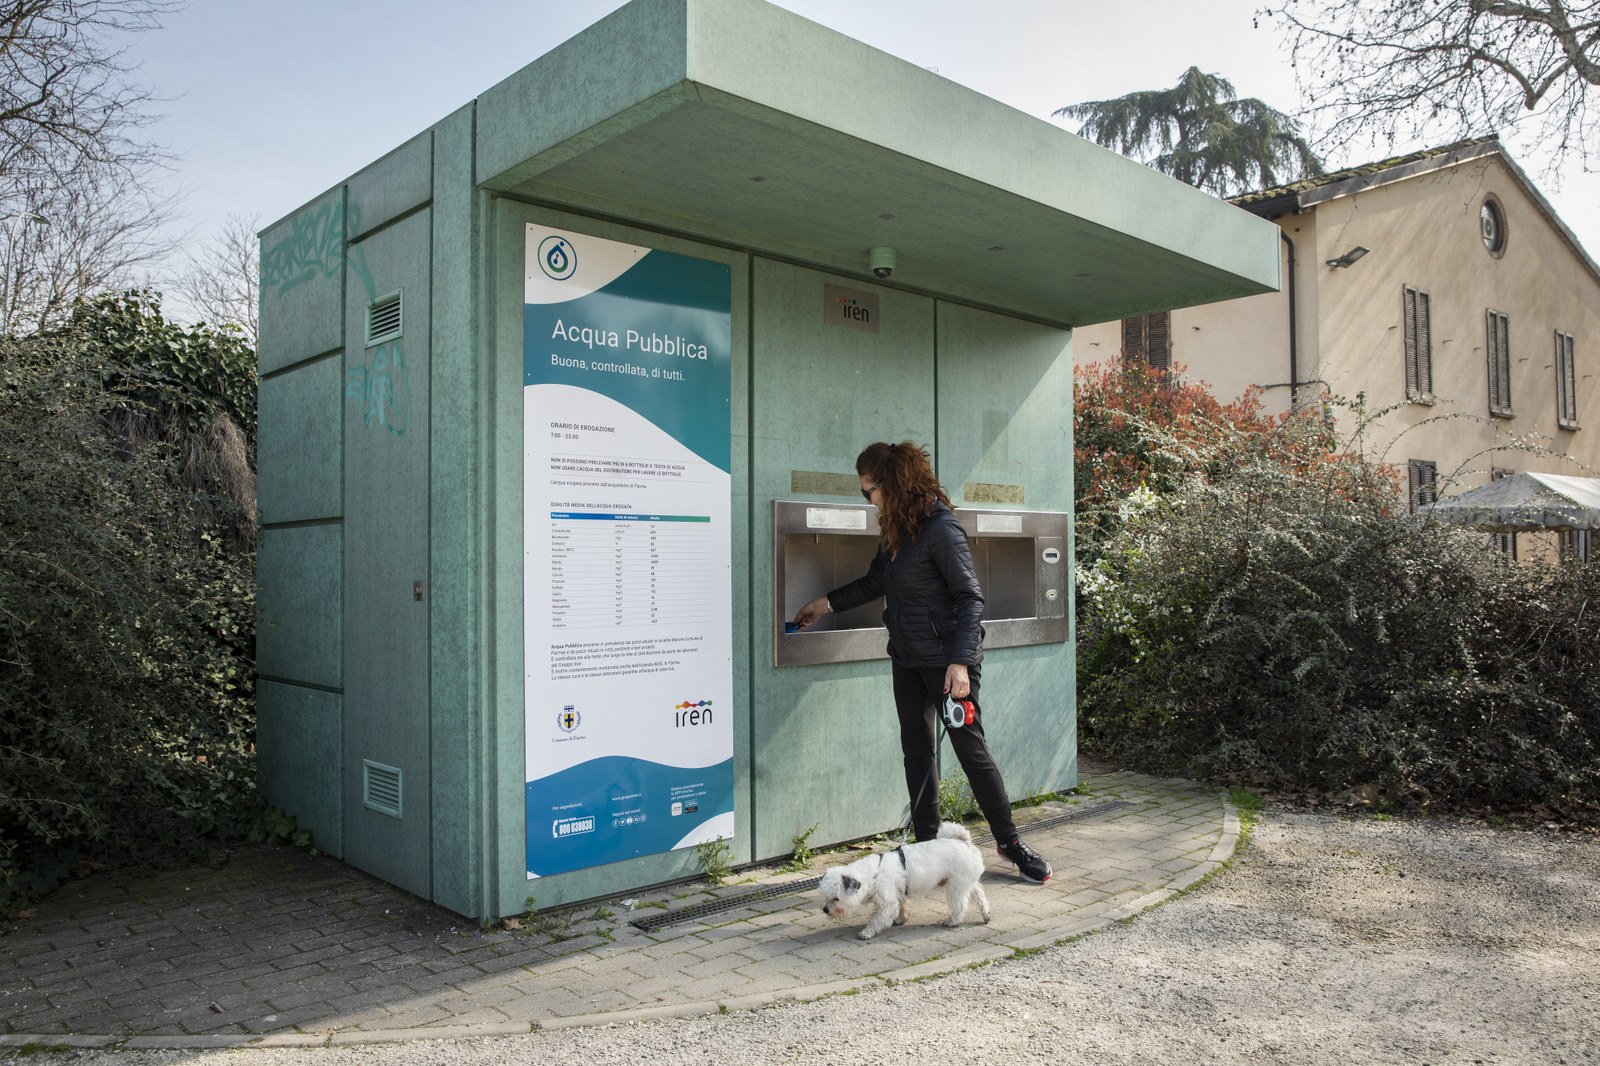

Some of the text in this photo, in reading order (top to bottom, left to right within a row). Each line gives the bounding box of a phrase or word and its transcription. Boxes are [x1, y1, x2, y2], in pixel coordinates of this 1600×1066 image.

[844, 304, 869, 322] iren
[552, 319, 708, 360] Acqua Pubblica
[551, 354, 685, 381] Buona, controllata, di tutti.
[580, 424, 615, 433] EROGAZIONE
[676, 708, 713, 728] iren
[559, 824, 570, 835] 800
